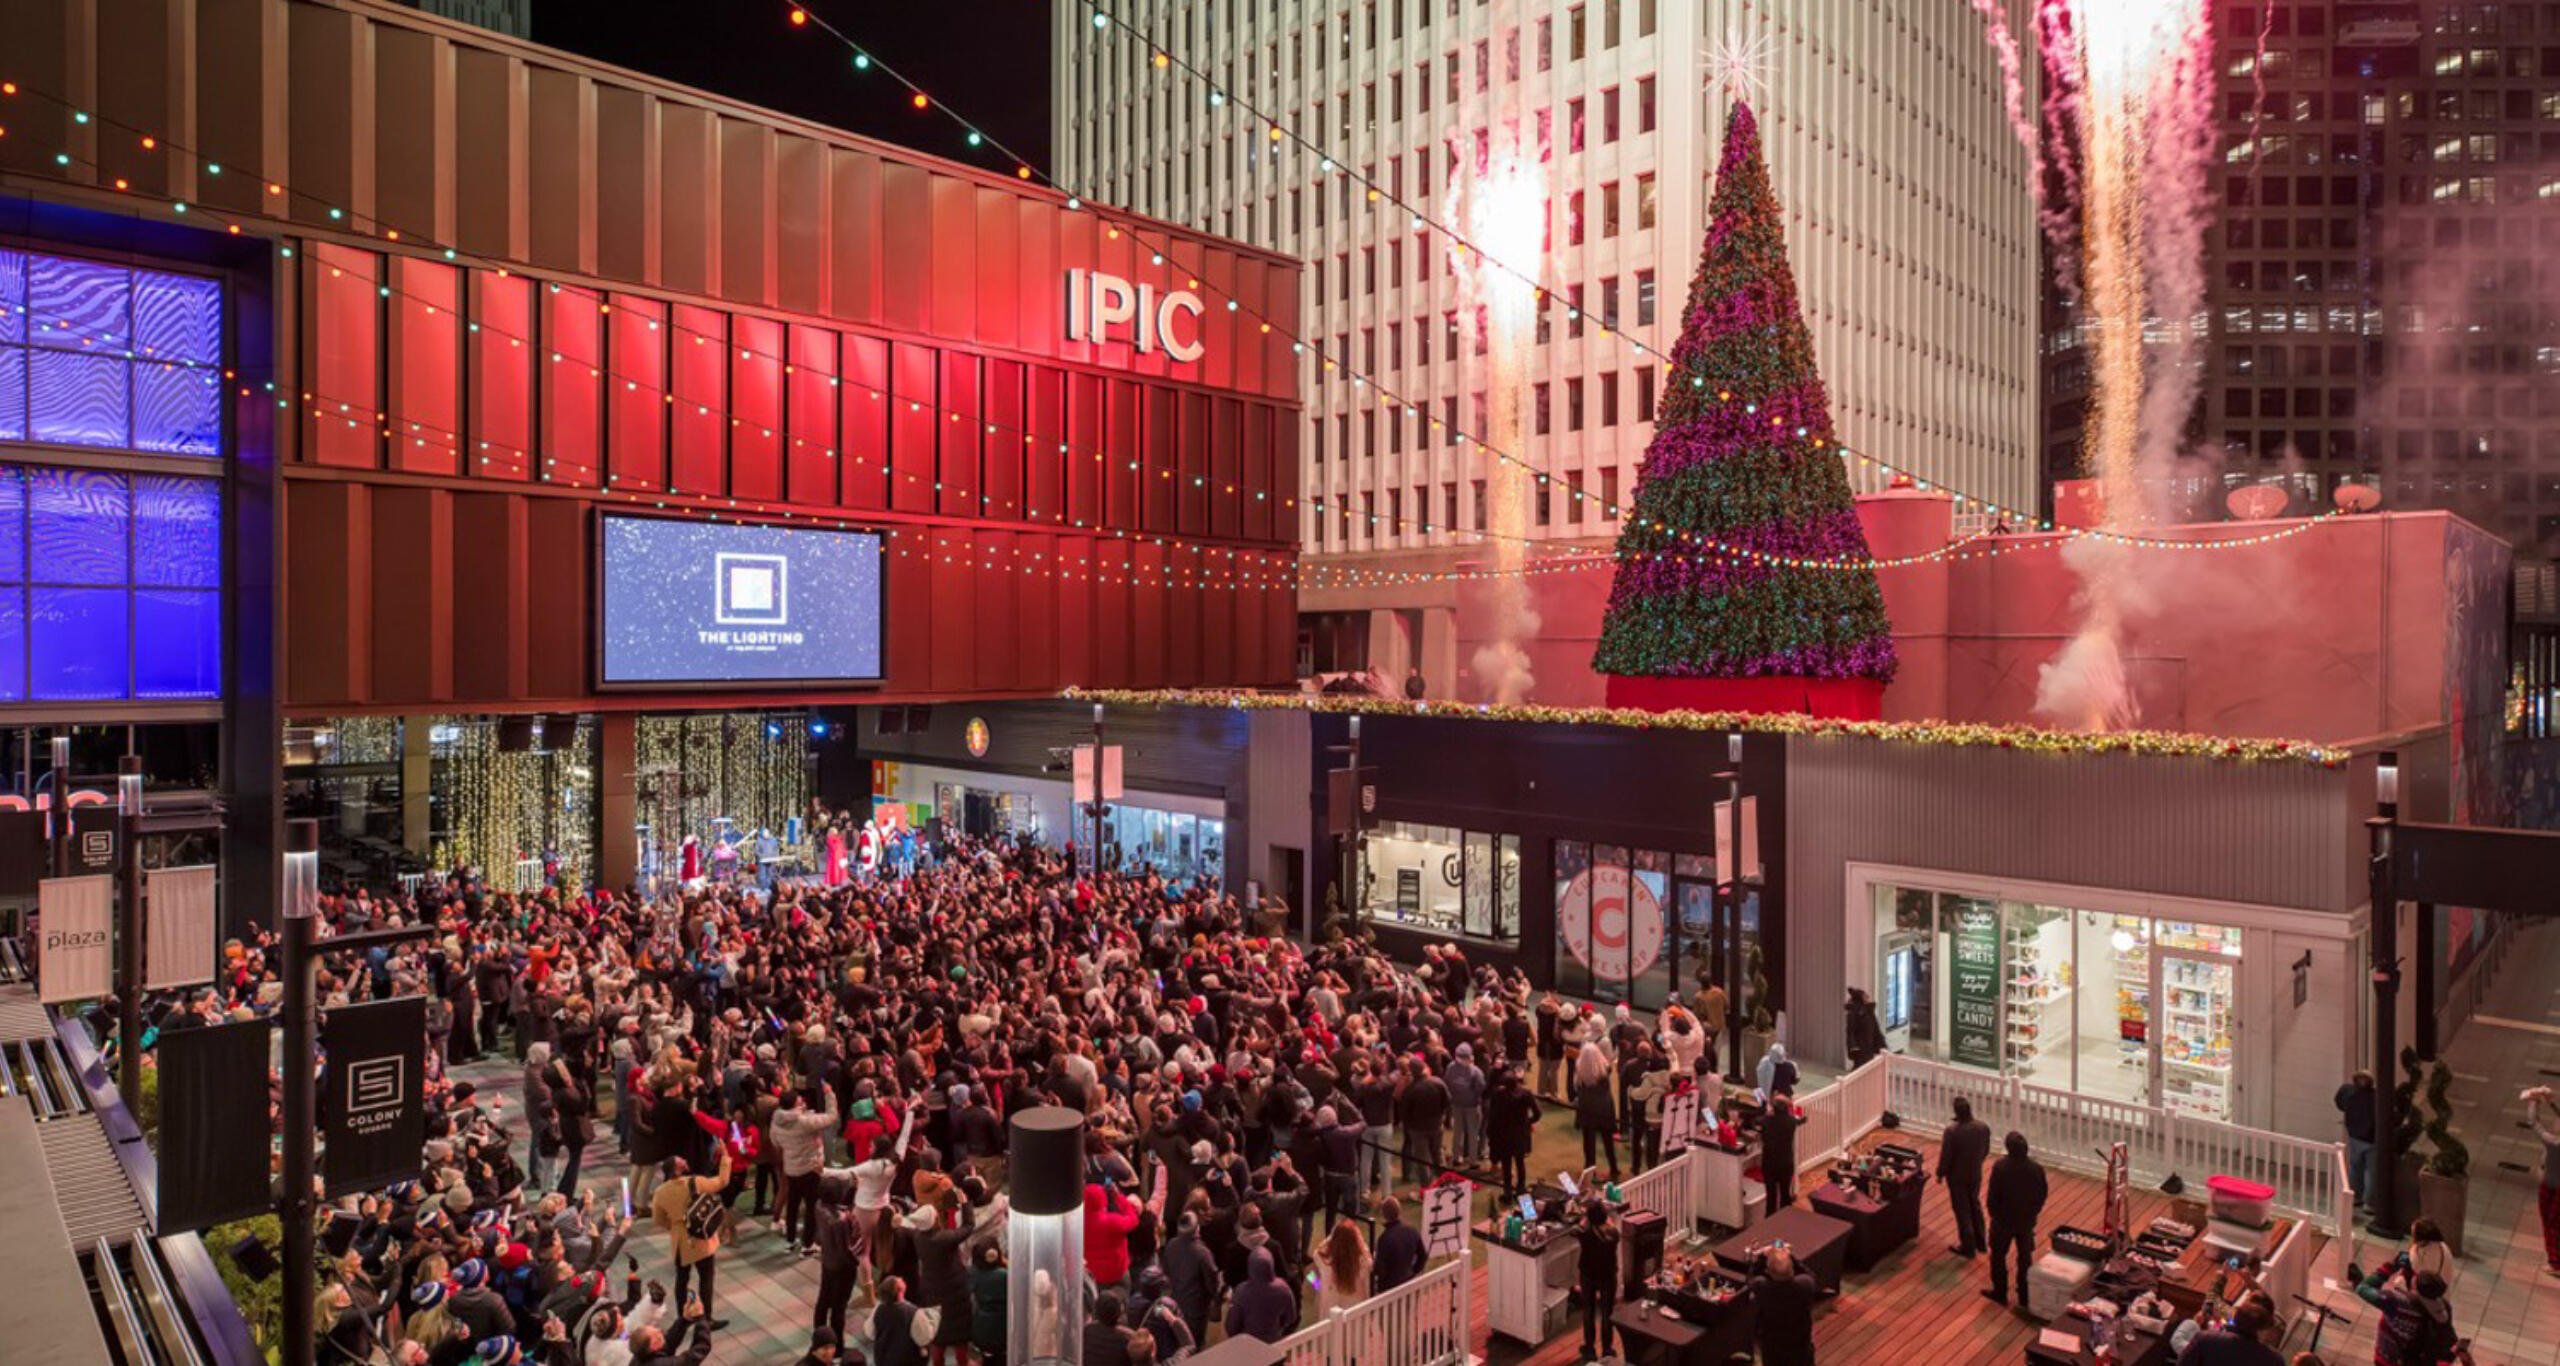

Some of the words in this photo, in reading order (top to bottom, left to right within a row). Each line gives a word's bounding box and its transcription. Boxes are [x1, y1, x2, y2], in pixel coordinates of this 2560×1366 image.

[1066, 267, 1206, 363] IPIC
[698, 631, 729, 645] THE
[47, 930, 105, 951] plaza
[1957, 1009, 1994, 1028] CANDY
[347, 1107, 403, 1128] COLONY
